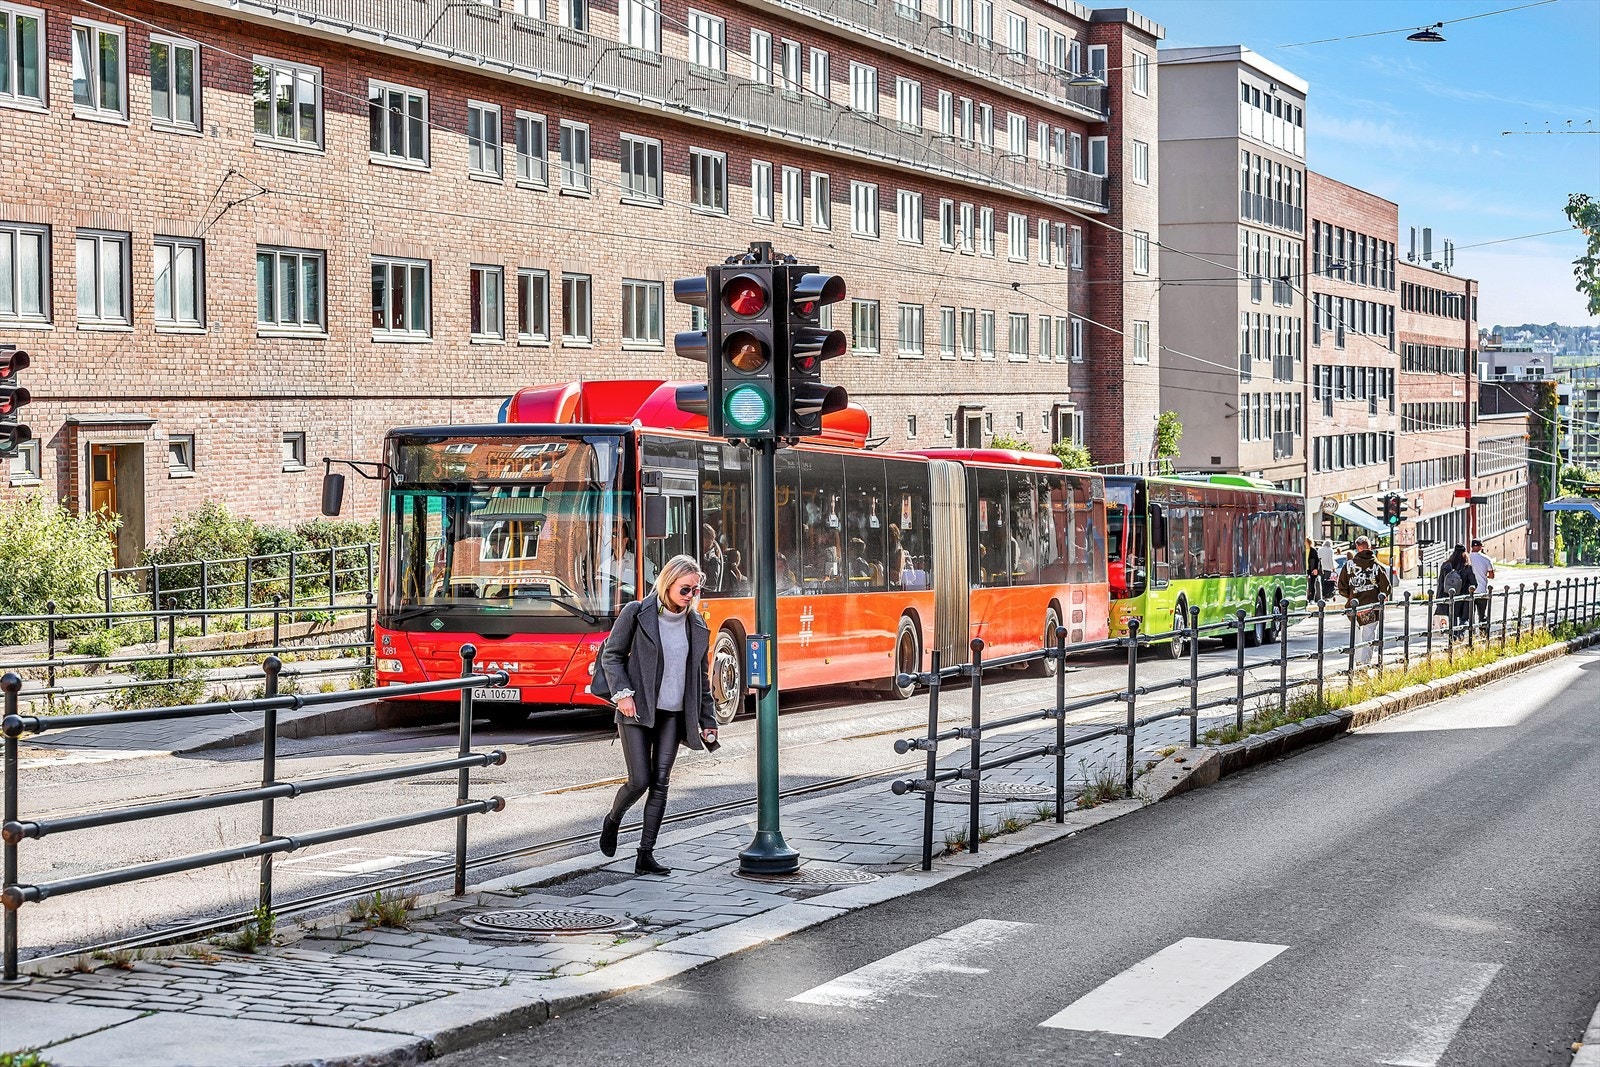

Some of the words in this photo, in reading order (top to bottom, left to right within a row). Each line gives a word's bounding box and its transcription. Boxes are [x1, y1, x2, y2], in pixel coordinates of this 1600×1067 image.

[382, 646, 397, 656] 1281
[472, 661, 519, 672] MAN
[474, 689, 487, 699] GA
[490, 689, 517, 699] 10677
